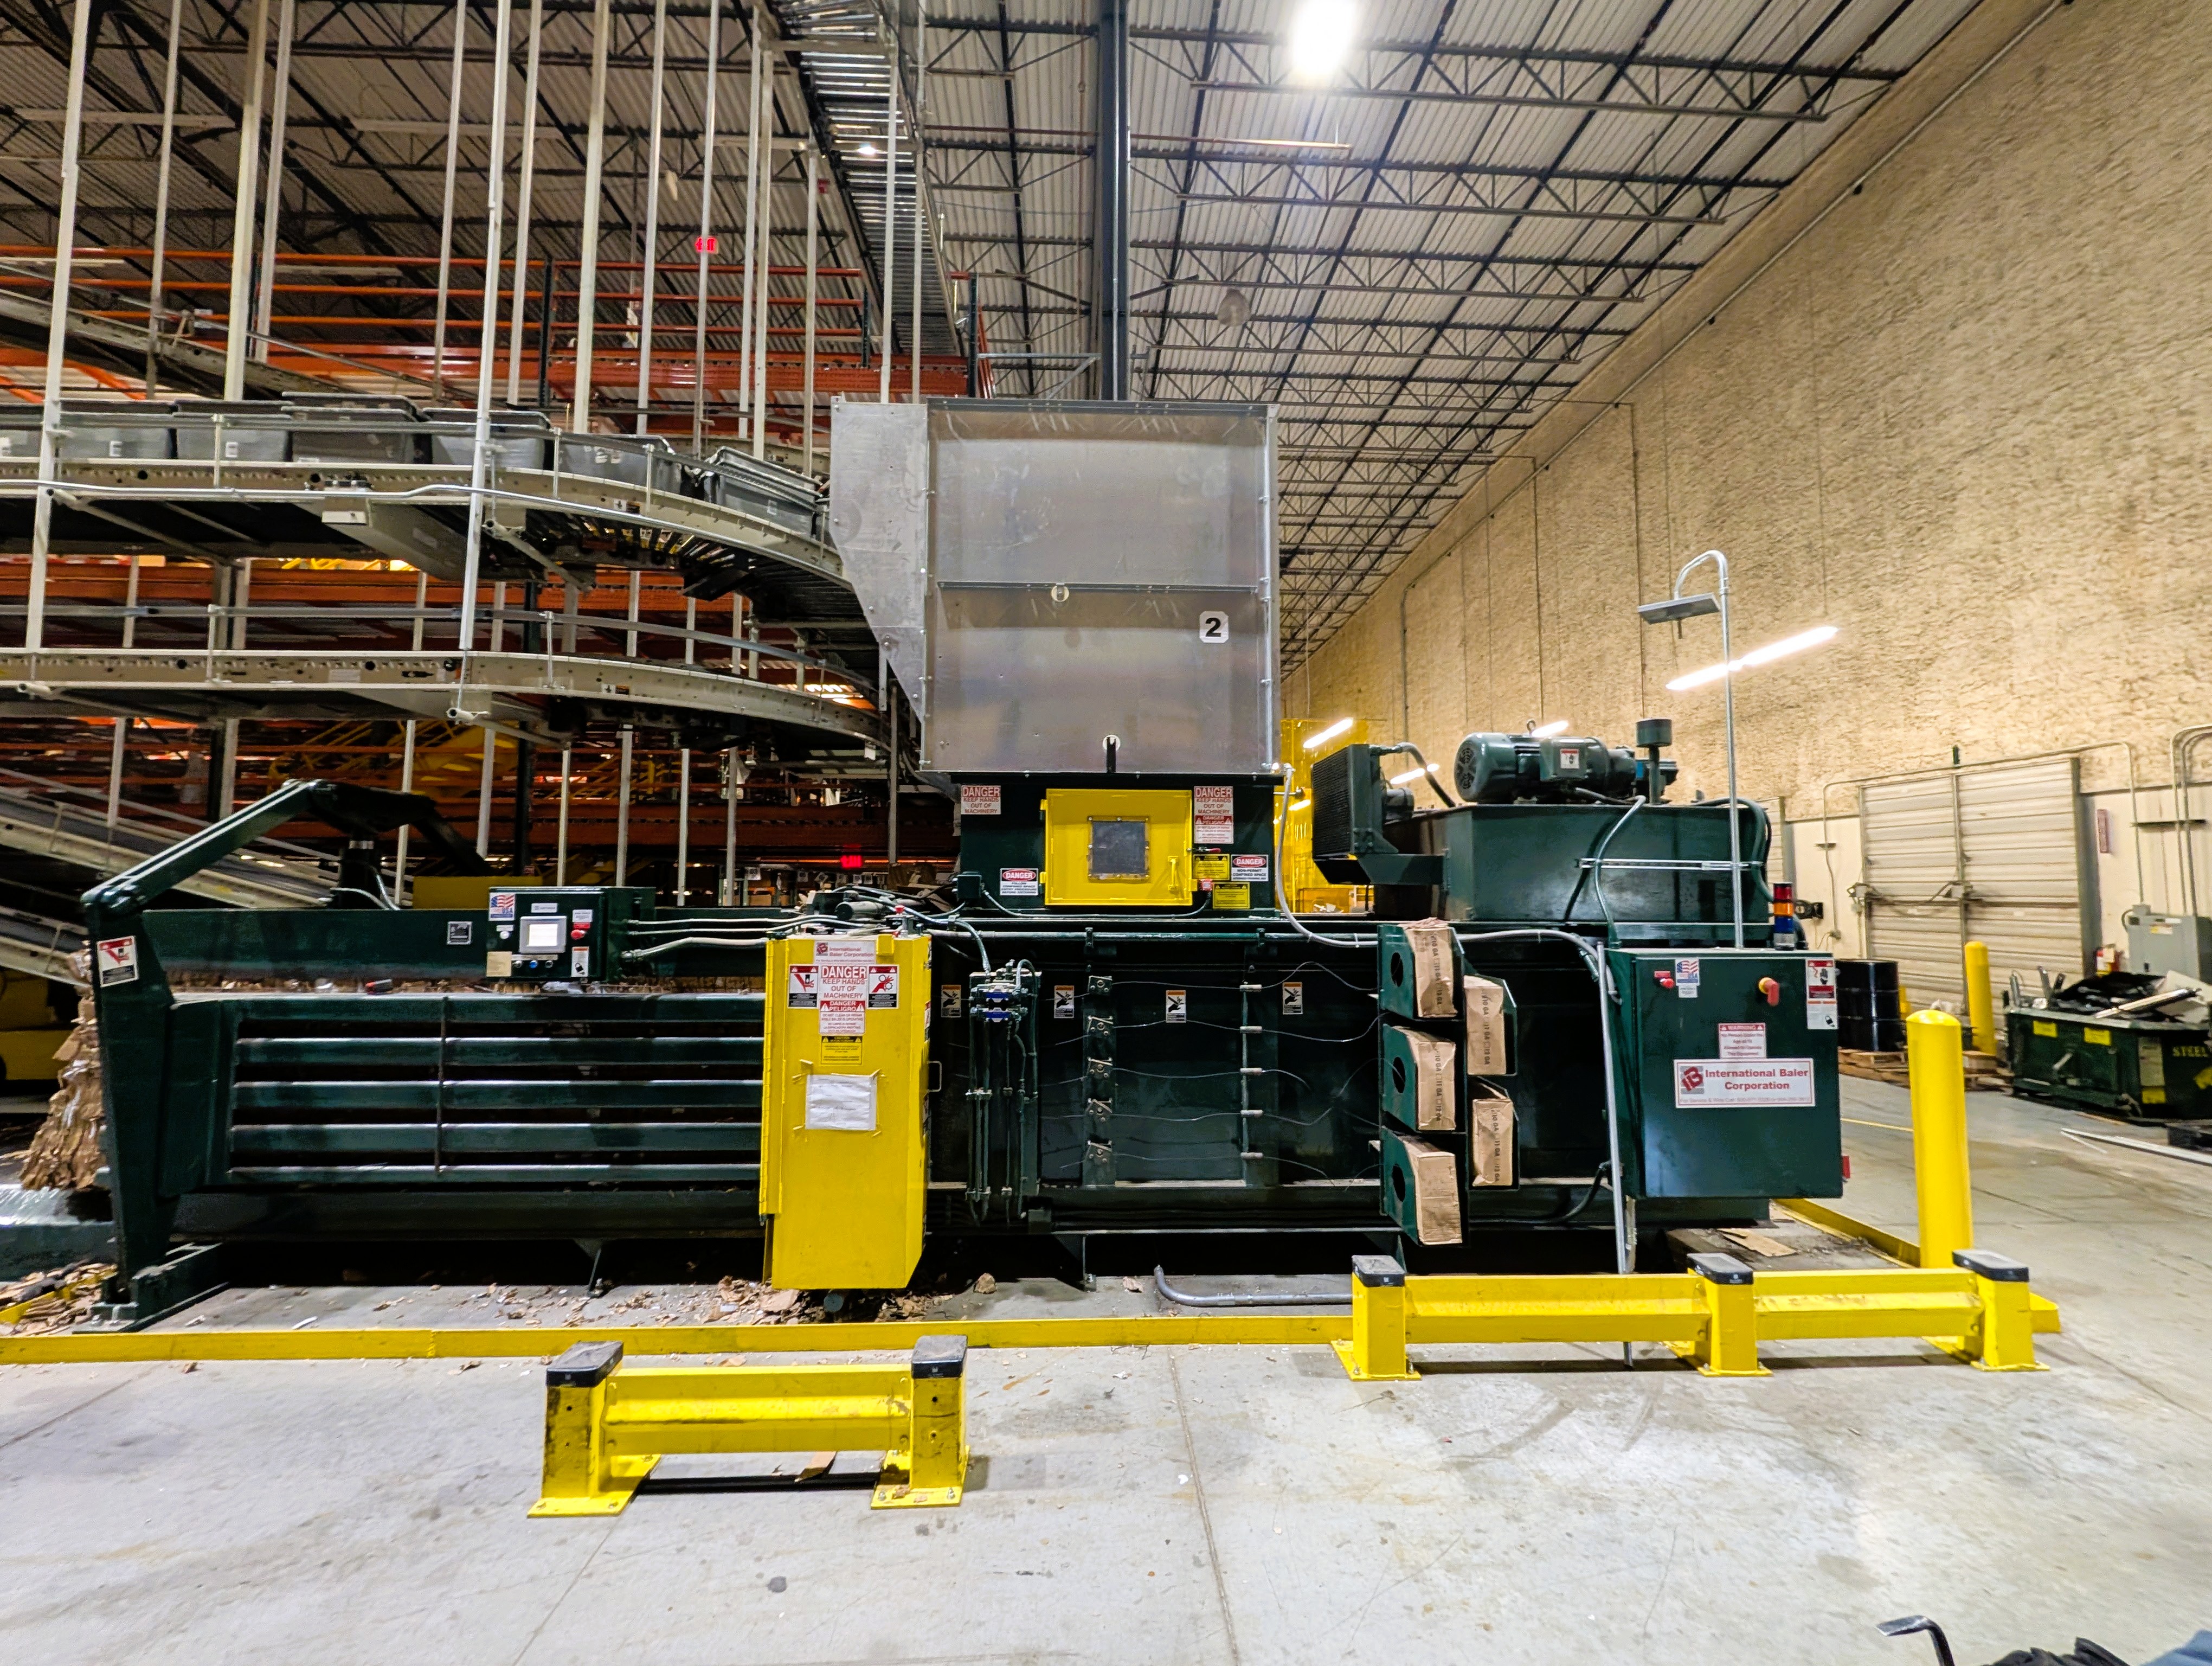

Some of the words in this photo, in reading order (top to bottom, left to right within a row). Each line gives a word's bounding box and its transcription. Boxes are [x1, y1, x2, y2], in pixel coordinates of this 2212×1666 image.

[1205, 617, 1221, 637] 2
[962, 787, 1000, 797] DANGER
[1195, 787, 1232, 797] DANGER
[822, 966, 866, 978] DANGER
[1432, 948, 1438, 957] GA
[1437, 997, 1443, 1005] GA
[1483, 1007, 1489, 1015] GA
[1484, 1031, 1490, 1040] GA
[2172, 1046, 2208, 1057] STEEL
[1435, 1063, 1441, 1072] GA
[1705, 1068, 1776, 1078] International
[1779, 1068, 1808, 1077] Baler
[1725, 1081, 1790, 1091] Corporation
[1436, 1088, 1442, 1096] GA
[1493, 1123, 1499, 1131] GA
[1495, 1148, 1501, 1157] GA
[1495, 1174, 1500, 1182] GA
